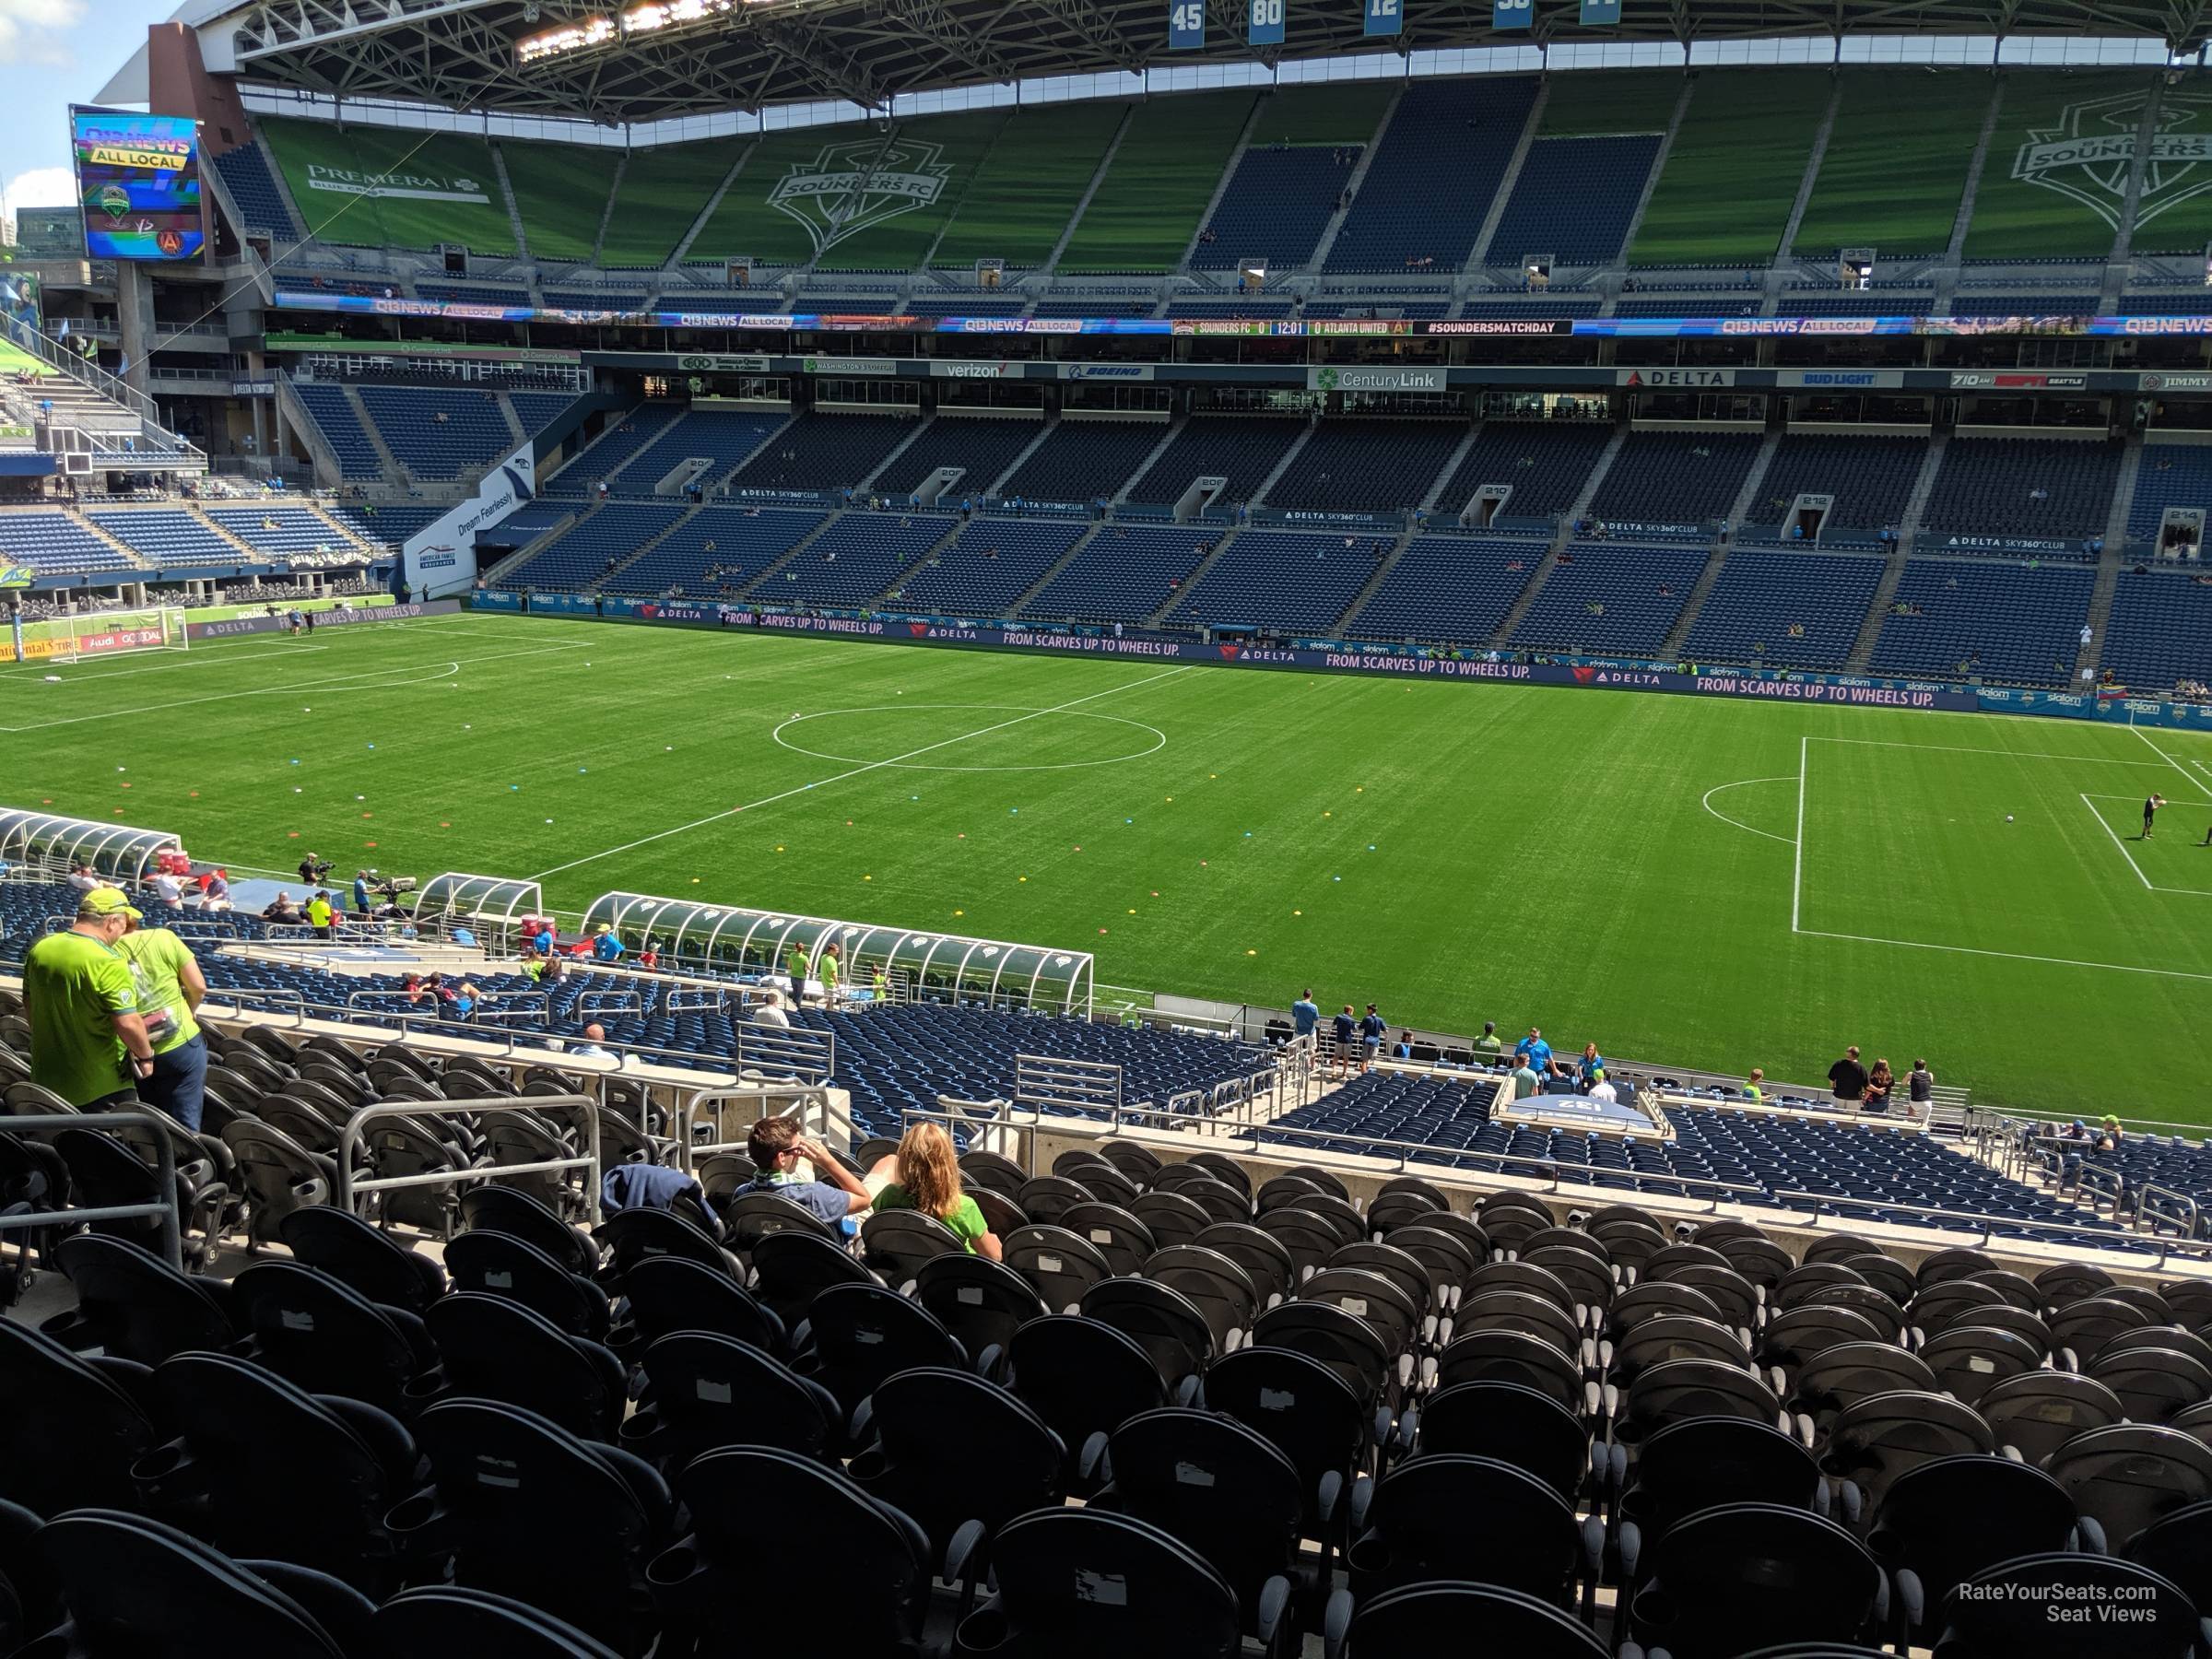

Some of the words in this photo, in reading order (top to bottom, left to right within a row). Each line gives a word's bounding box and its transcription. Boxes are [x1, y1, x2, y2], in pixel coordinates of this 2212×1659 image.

[1171, 5, 1202, 30] 45
[1253, 0, 1281, 26] 80
[2081, 137, 2206, 147] SEATLE
[96, 150, 125, 163] ALL
[130, 154, 179, 168] LOCAL
[307, 164, 440, 188] PREMERA
[824, 173, 905, 182] SEATLE
[313, 182, 342, 192] BLUE
[907, 183, 931, 195] FC
[401, 303, 441, 315] NEWS
[445, 307, 465, 316] ALL
[468, 308, 500, 317] LOCAL
[702, 316, 737, 326] NEWS
[741, 317, 758, 325] ALL
[759, 318, 790, 326] LOCAL
[989, 321, 1023, 332] NEWS
[2125, 319, 2157, 332] Q13
[2160, 319, 2212, 333] NEWS
[1199, 322, 1239, 333] SOUNDERS
[1241, 323, 1251, 333] FC
[1277, 322, 1302, 334] 12:01
[1324, 323, 1358, 334] ATLANTA
[1359, 323, 1387, 334] UNITED
[1429, 323, 1555, 334] #SOUNDERSMATCHDAY
[1752, 321, 1797, 333] NEWS
[1804, 323, 1826, 331] ALL
[1830, 323, 1869, 331] LOCAL
[947, 364, 999, 378] verizon
[1086, 367, 1142, 376] BOEING
[1343, 372, 1434, 389] CenturyLink
[1652, 371, 1724, 385] DELTA
[1804, 374, 1833, 383] BUD
[1834, 374, 1875, 384] LIGHT
[1952, 374, 1979, 385] 710
[2164, 377, 2209, 386] JIMMY
[458, 514, 480, 537] Dream
[480, 492, 512, 522] Fearlessly
[2171, 511, 2197, 519] 214
[1609, 523, 1641, 531] DELTA
[1961, 537, 2000, 547] DELTA
[623, 597, 645, 606] slalom
[669, 600, 691, 608] slalom
[278, 616, 309, 629] FR
[312, 611, 347, 626] CARVES
[348, 609, 360, 622] UP
[362, 608, 374, 620] TO
[376, 606, 409, 618] WHEELS
[410, 605, 423, 617] UP.
[668, 609, 701, 619] DELTA
[218, 622, 254, 633] DELTA
[725, 612, 752, 624] FROM
[754, 614, 795, 628] CARVES
[797, 617, 810, 629] UP
[813, 618, 826, 630] TO
[829, 619, 866, 633] WHEELS
[869, 622, 884, 635] UP.
[940, 629, 977, 640] DELTA
[89, 636, 115, 646] Audi
[1003, 632, 1033, 645] FROM
[1035, 635, 1082, 649] SCARVES
[1084, 638, 1098, 651] UP
[1100, 639, 1115, 652] TO
[1118, 640, 1160, 654] WHEELS
[1163, 642, 1181, 656] UP.
[1310, 641, 1335, 651] slalom
[1253, 650, 1295, 662] DELTA
[1326, 654, 1360, 668] FROM
[1362, 656, 1416, 672] SCARVES
[1418, 659, 1435, 673] UP
[1439, 660, 1455, 674] TO
[1459, 662, 1509, 677] WHEELS
[1512, 665, 1530, 678] UP.
[1710, 667, 1740, 677] slalom
[1612, 673, 1660, 685] DELTA
[1839, 677, 1870, 687] slalom
[1697, 677, 1735, 692] FROM
[1739, 680, 1801, 697] SCARVES
[1805, 683, 1824, 699] UP
[1829, 686, 1847, 700] TO
[1851, 688, 1908, 706] WHEELS
[1912, 692, 1934, 707] UP.
[1906, 682, 1938, 692] slalom
[1976, 688, 2009, 698] slalom
[2048, 693, 2081, 704] slalom
[2124, 700, 2159, 712] slalom
[1558, 1100, 1602, 1112] 132
